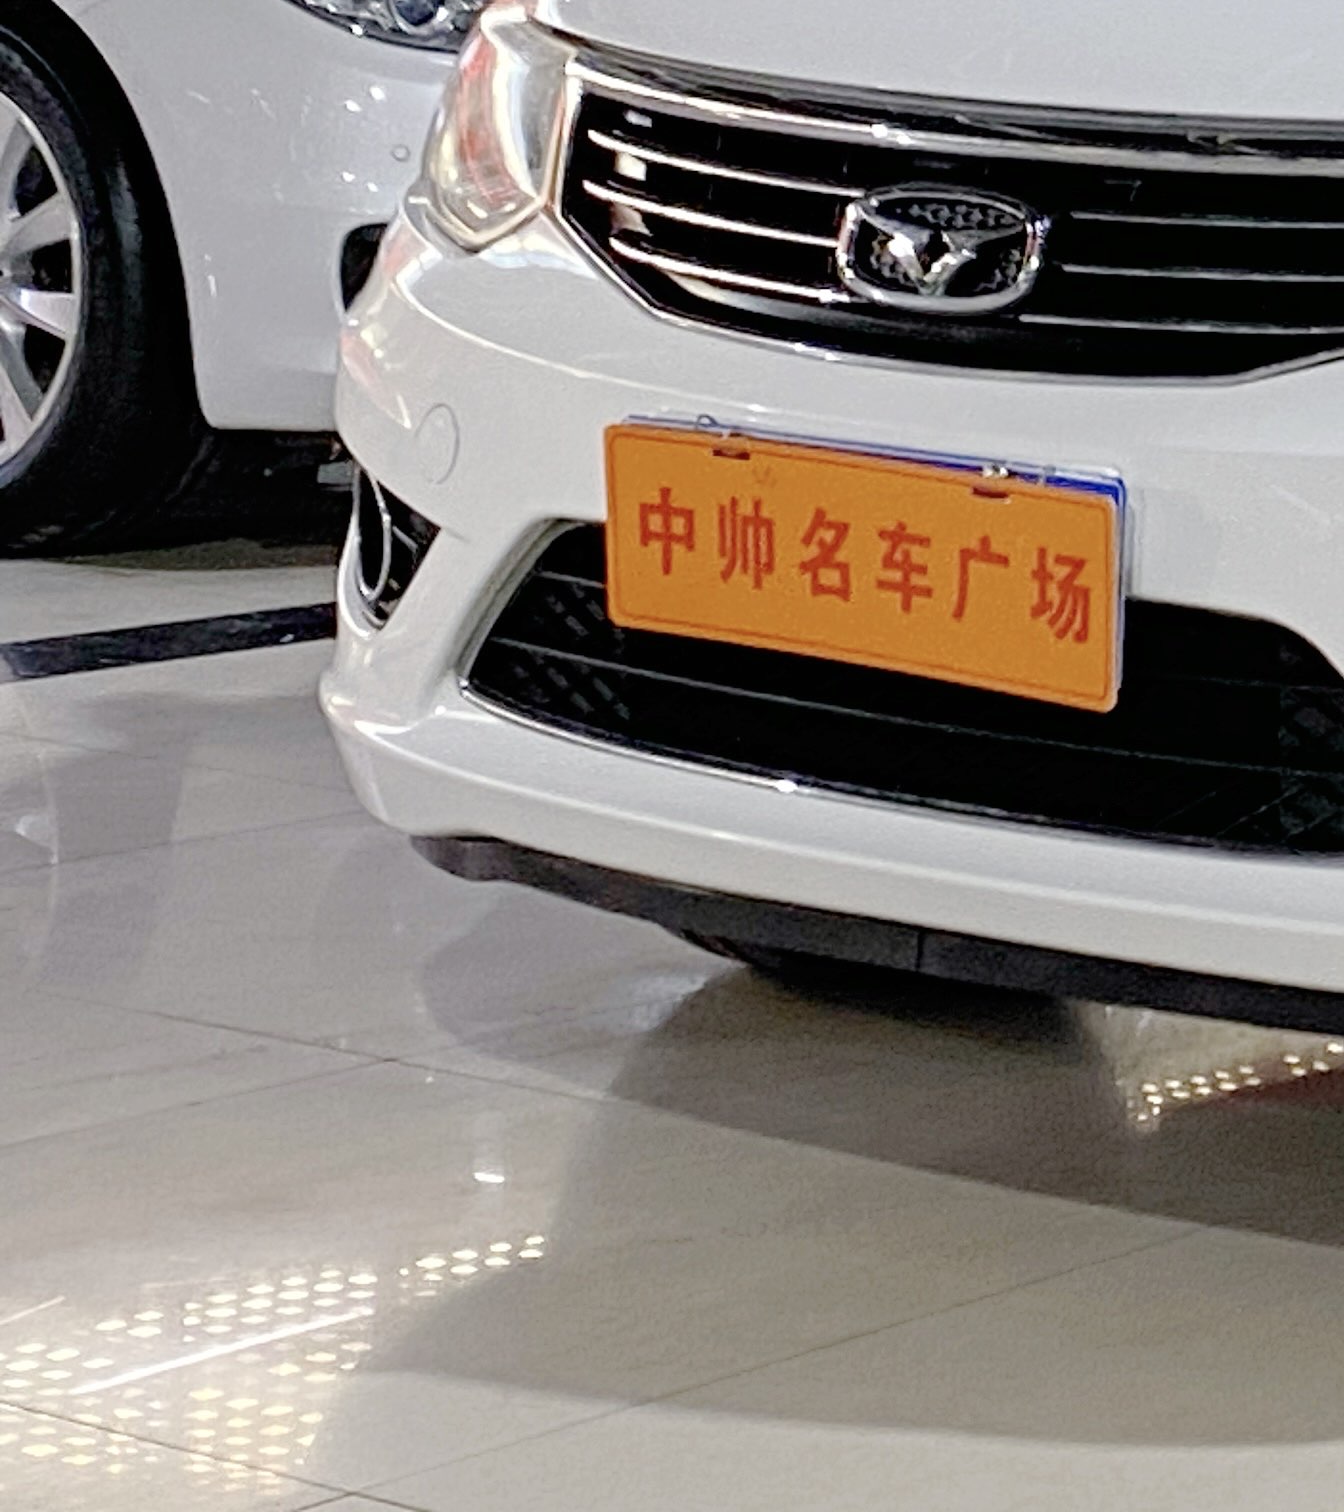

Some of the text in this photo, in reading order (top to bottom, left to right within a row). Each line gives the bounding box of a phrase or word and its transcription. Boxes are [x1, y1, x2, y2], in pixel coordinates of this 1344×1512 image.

[637, 487, 1093, 644] 中帅名车广场
